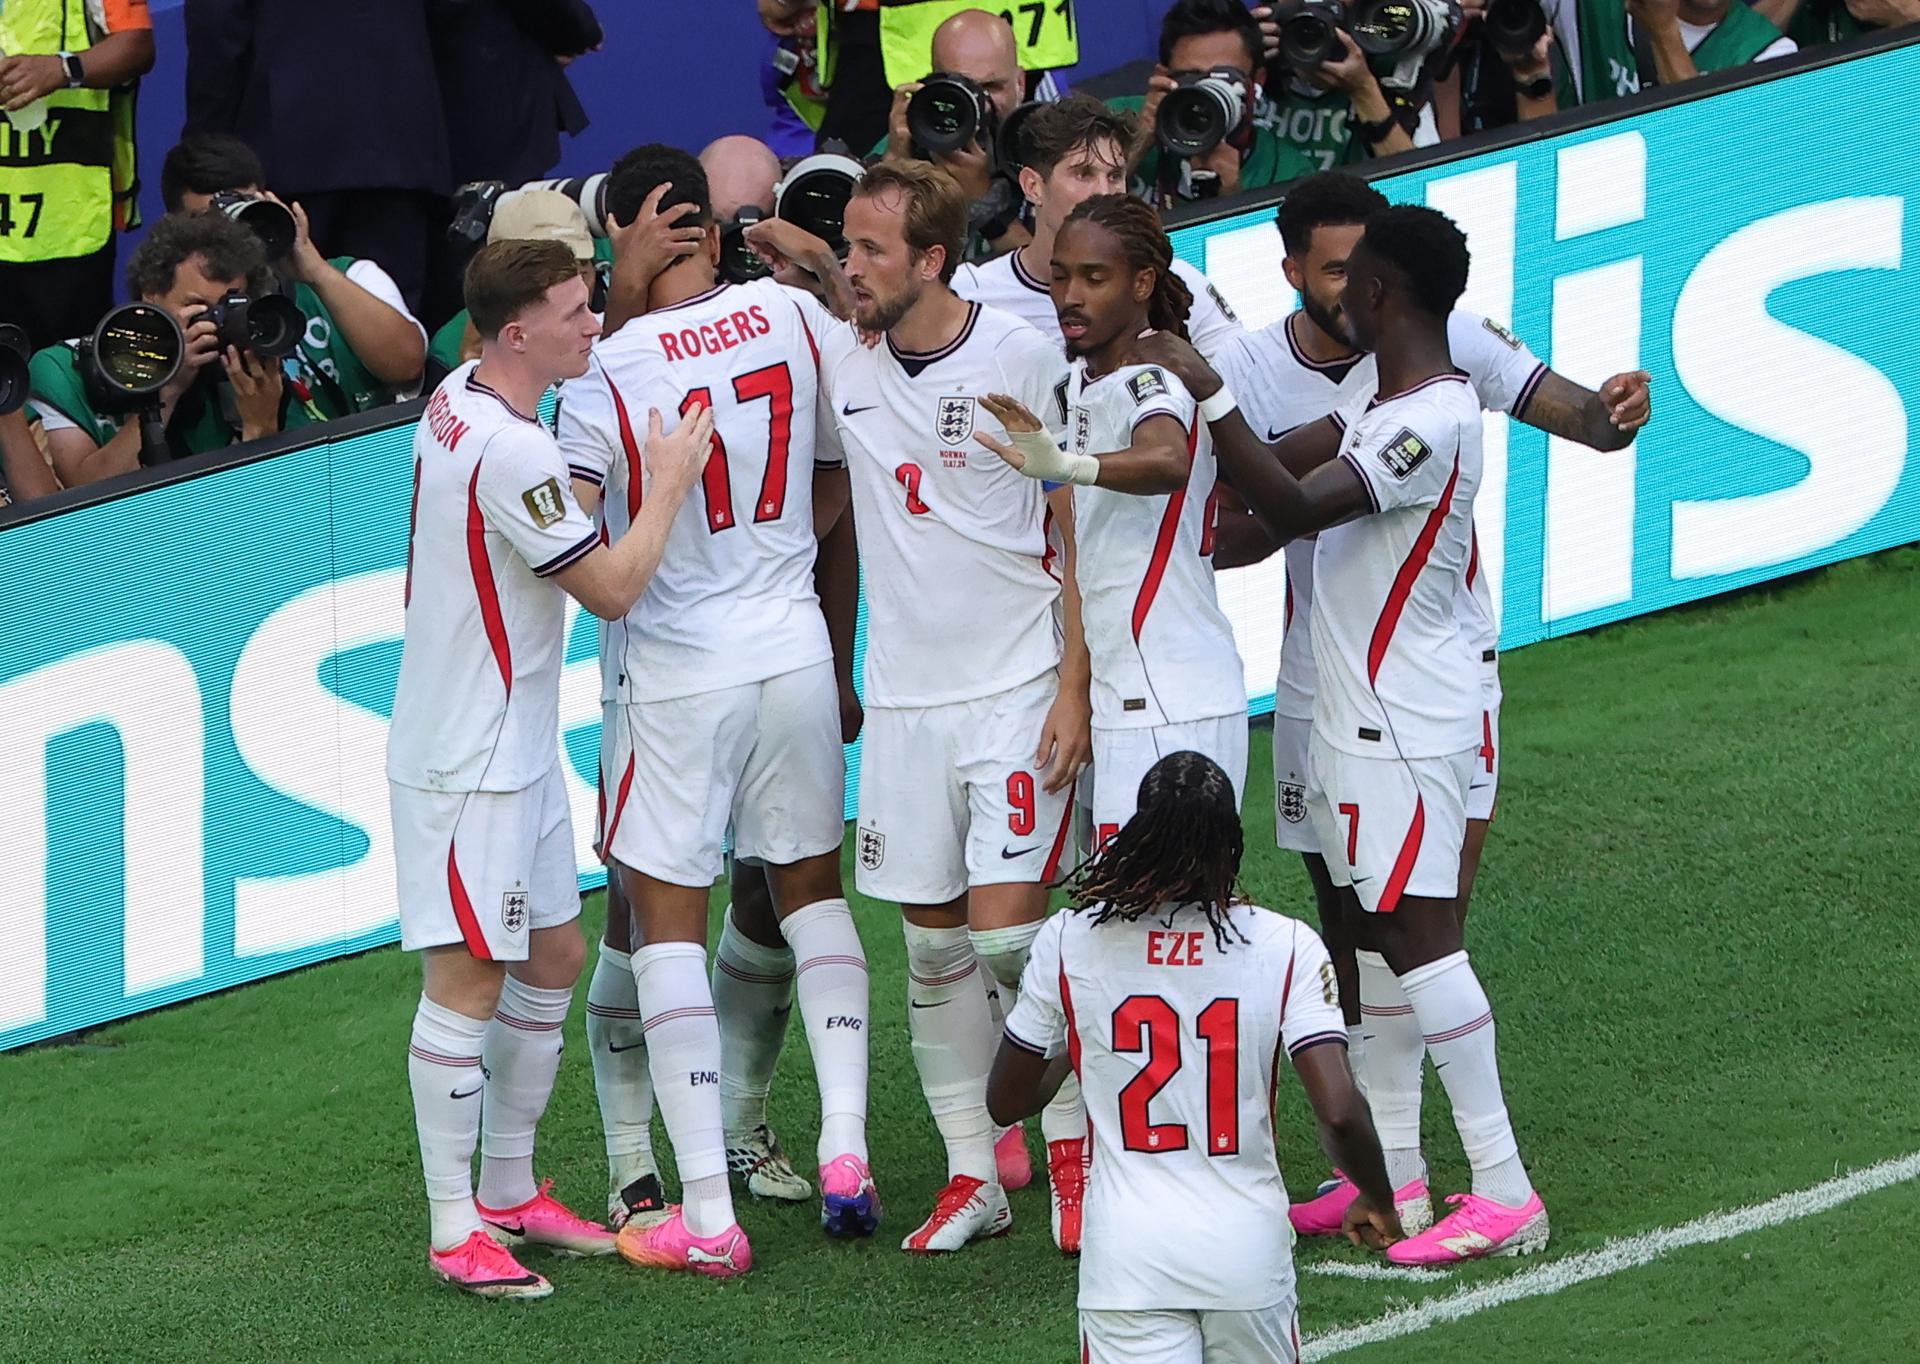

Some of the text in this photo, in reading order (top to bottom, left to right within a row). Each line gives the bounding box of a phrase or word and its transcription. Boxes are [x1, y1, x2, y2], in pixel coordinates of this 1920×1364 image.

[1000, 0, 1073, 47] 71
[658, 305, 770, 361] ROGERS
[678, 360, 793, 535] 17
[1479, 710, 1495, 774] 4
[1006, 770, 1036, 837] 9
[1338, 803, 1360, 867] 7
[1147, 930, 1205, 966] EZE
[826, 1016, 863, 1031] ENG
[690, 1071, 719, 1086] ENG
[1111, 995, 1239, 1156] 21
